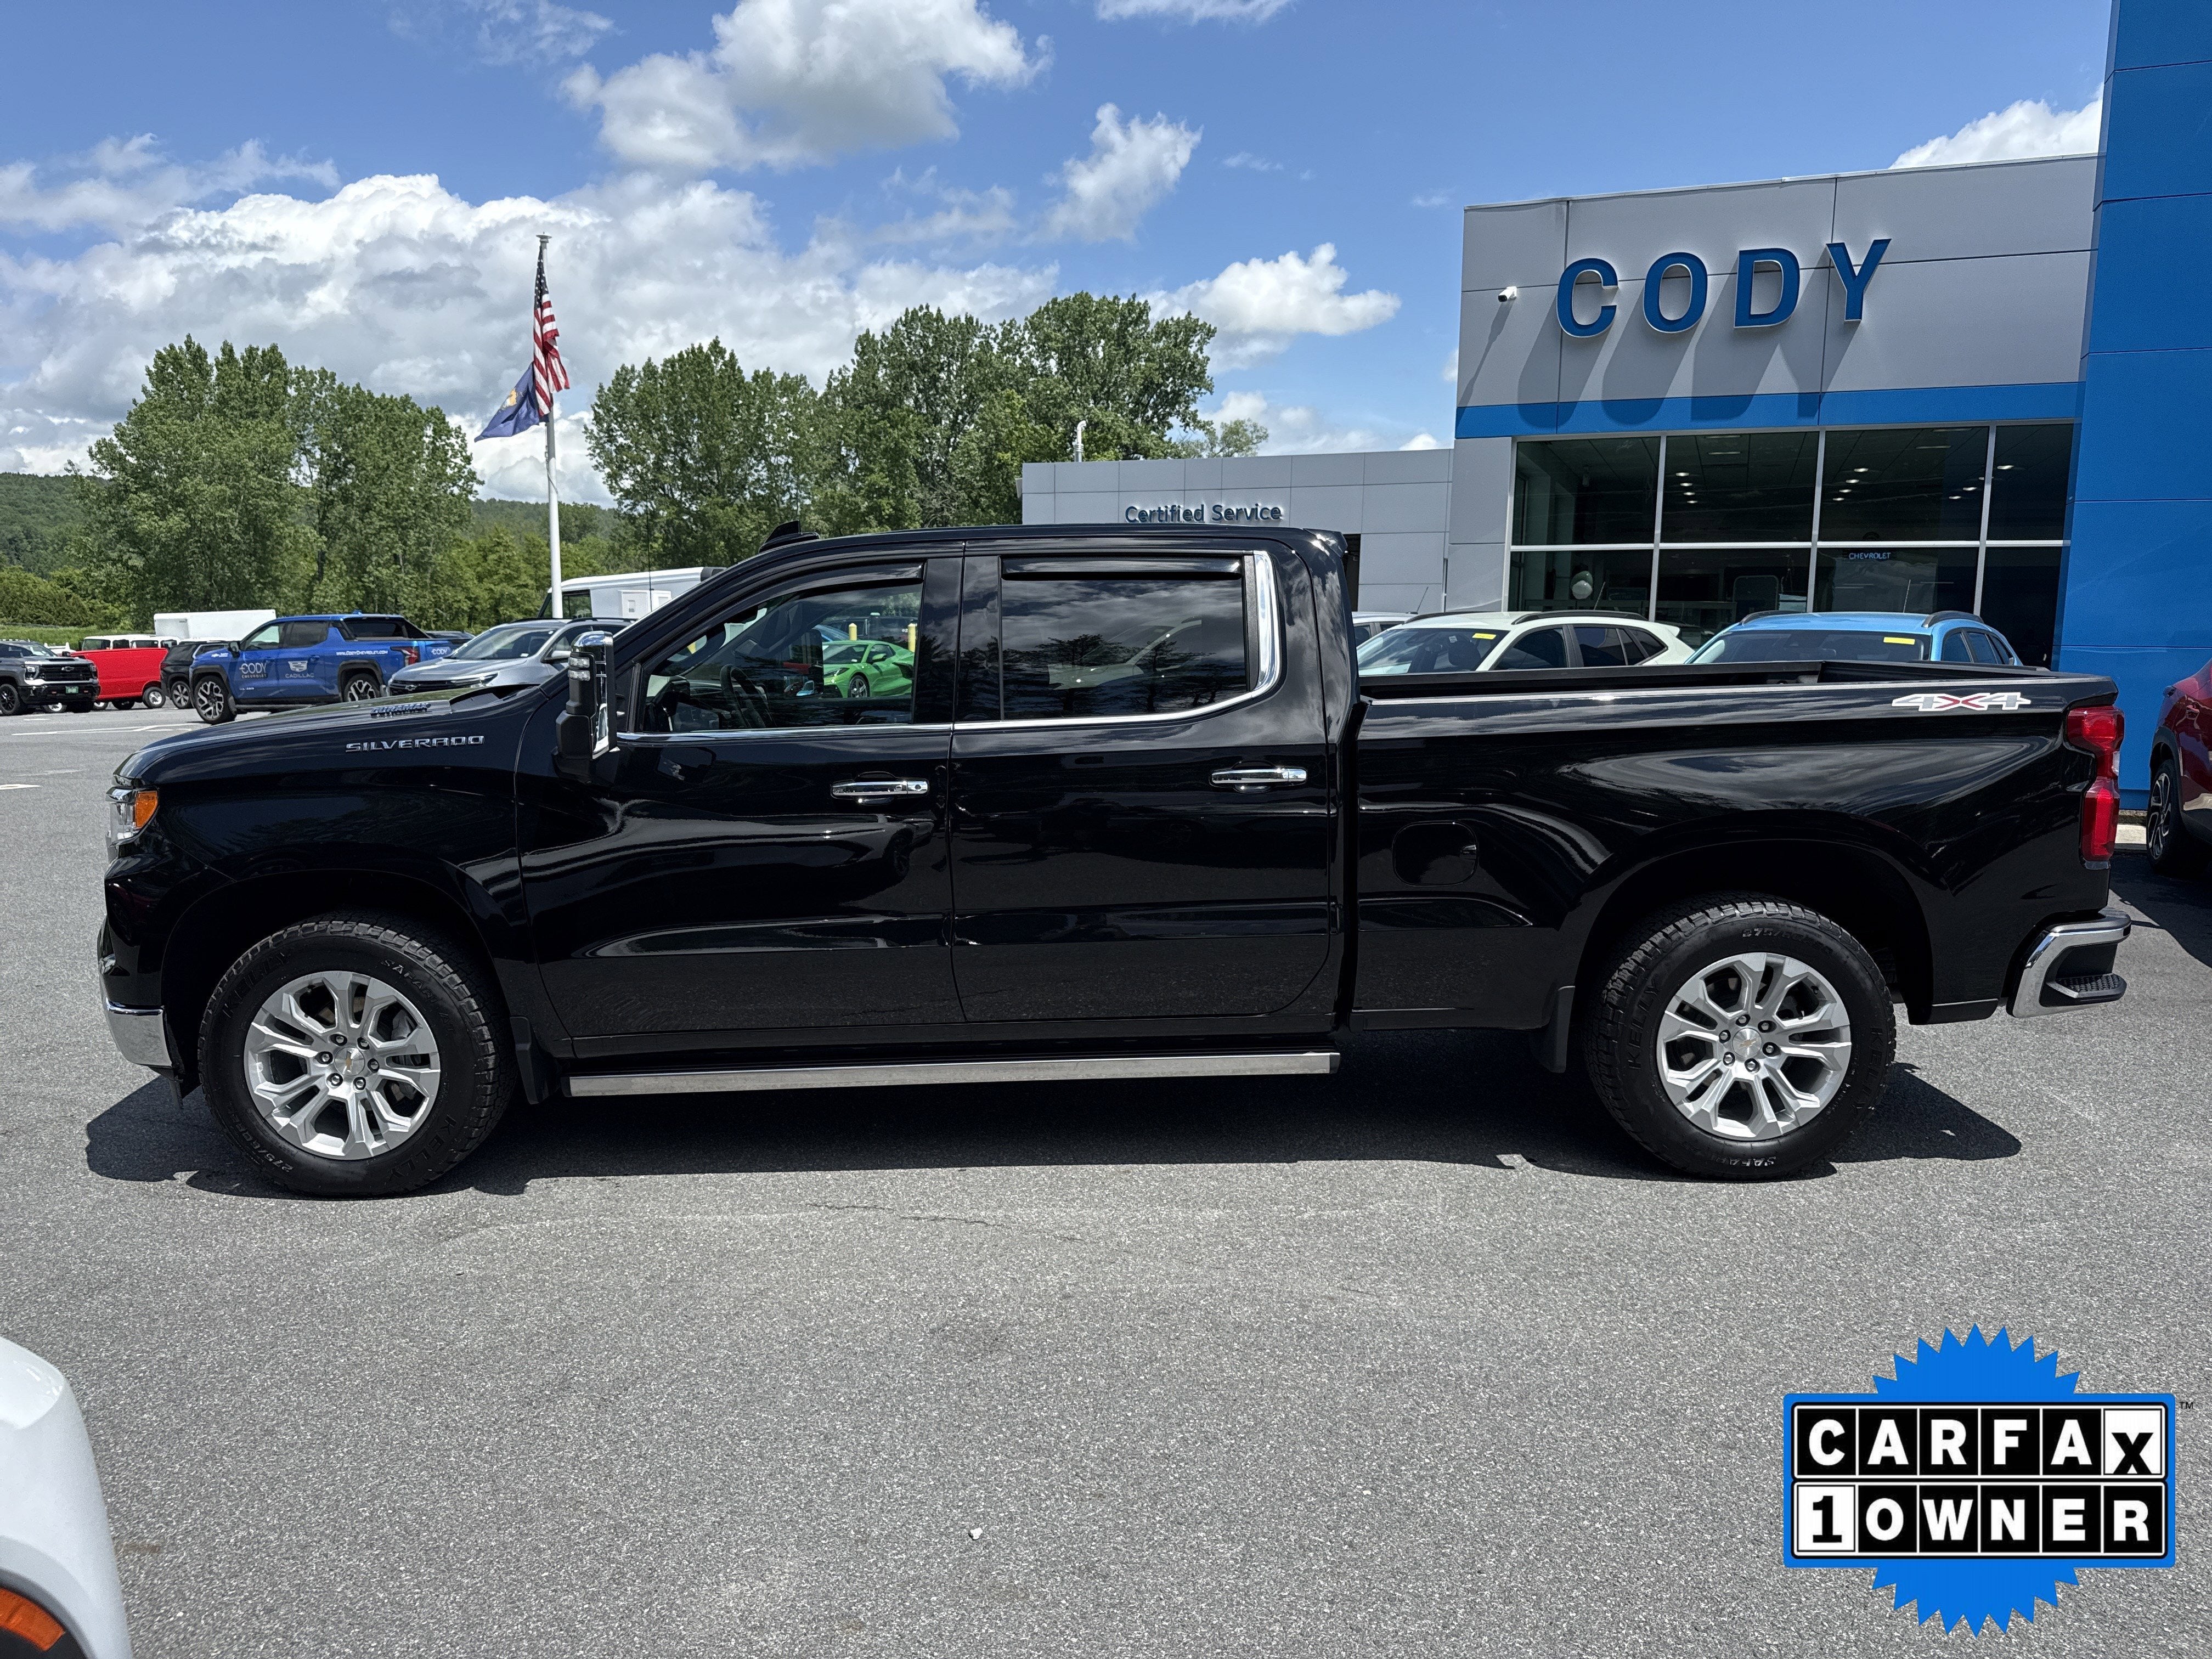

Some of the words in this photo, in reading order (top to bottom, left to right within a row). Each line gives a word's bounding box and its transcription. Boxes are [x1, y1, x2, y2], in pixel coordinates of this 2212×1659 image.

[1556, 239, 1892, 338] CODY
[1125, 504, 1204, 523] Certified
[1211, 503, 1282, 521] Service
[240, 662, 267, 674] CODY
[345, 736, 484, 753] SILVERADO
[379, 958, 438, 1004] SAFARI
[1627, 979, 1659, 1070] KELLY
[389, 1114, 457, 1181] KELLY
